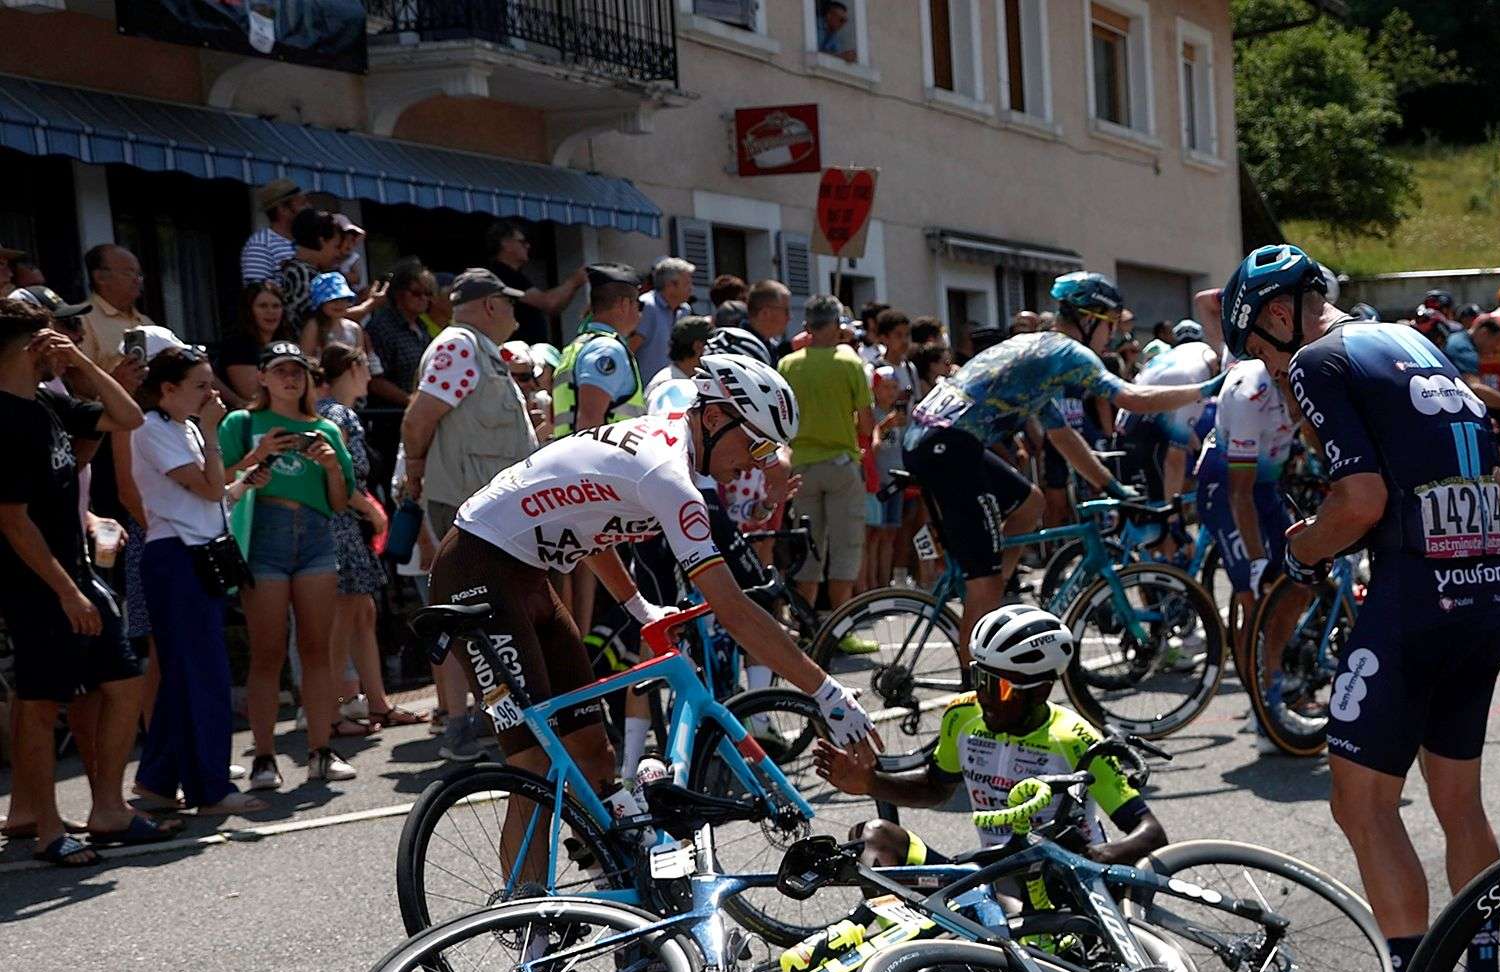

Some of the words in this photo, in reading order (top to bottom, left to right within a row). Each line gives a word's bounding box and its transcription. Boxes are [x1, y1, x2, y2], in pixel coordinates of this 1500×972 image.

[1230, 281, 1247, 324] SCOTT
[520, 479, 622, 518] CITROËN
[1425, 486, 1480, 536] 142
[533, 524, 582, 550] LA
[915, 534, 934, 559] 192
[1030, 634, 1057, 648] uvex
